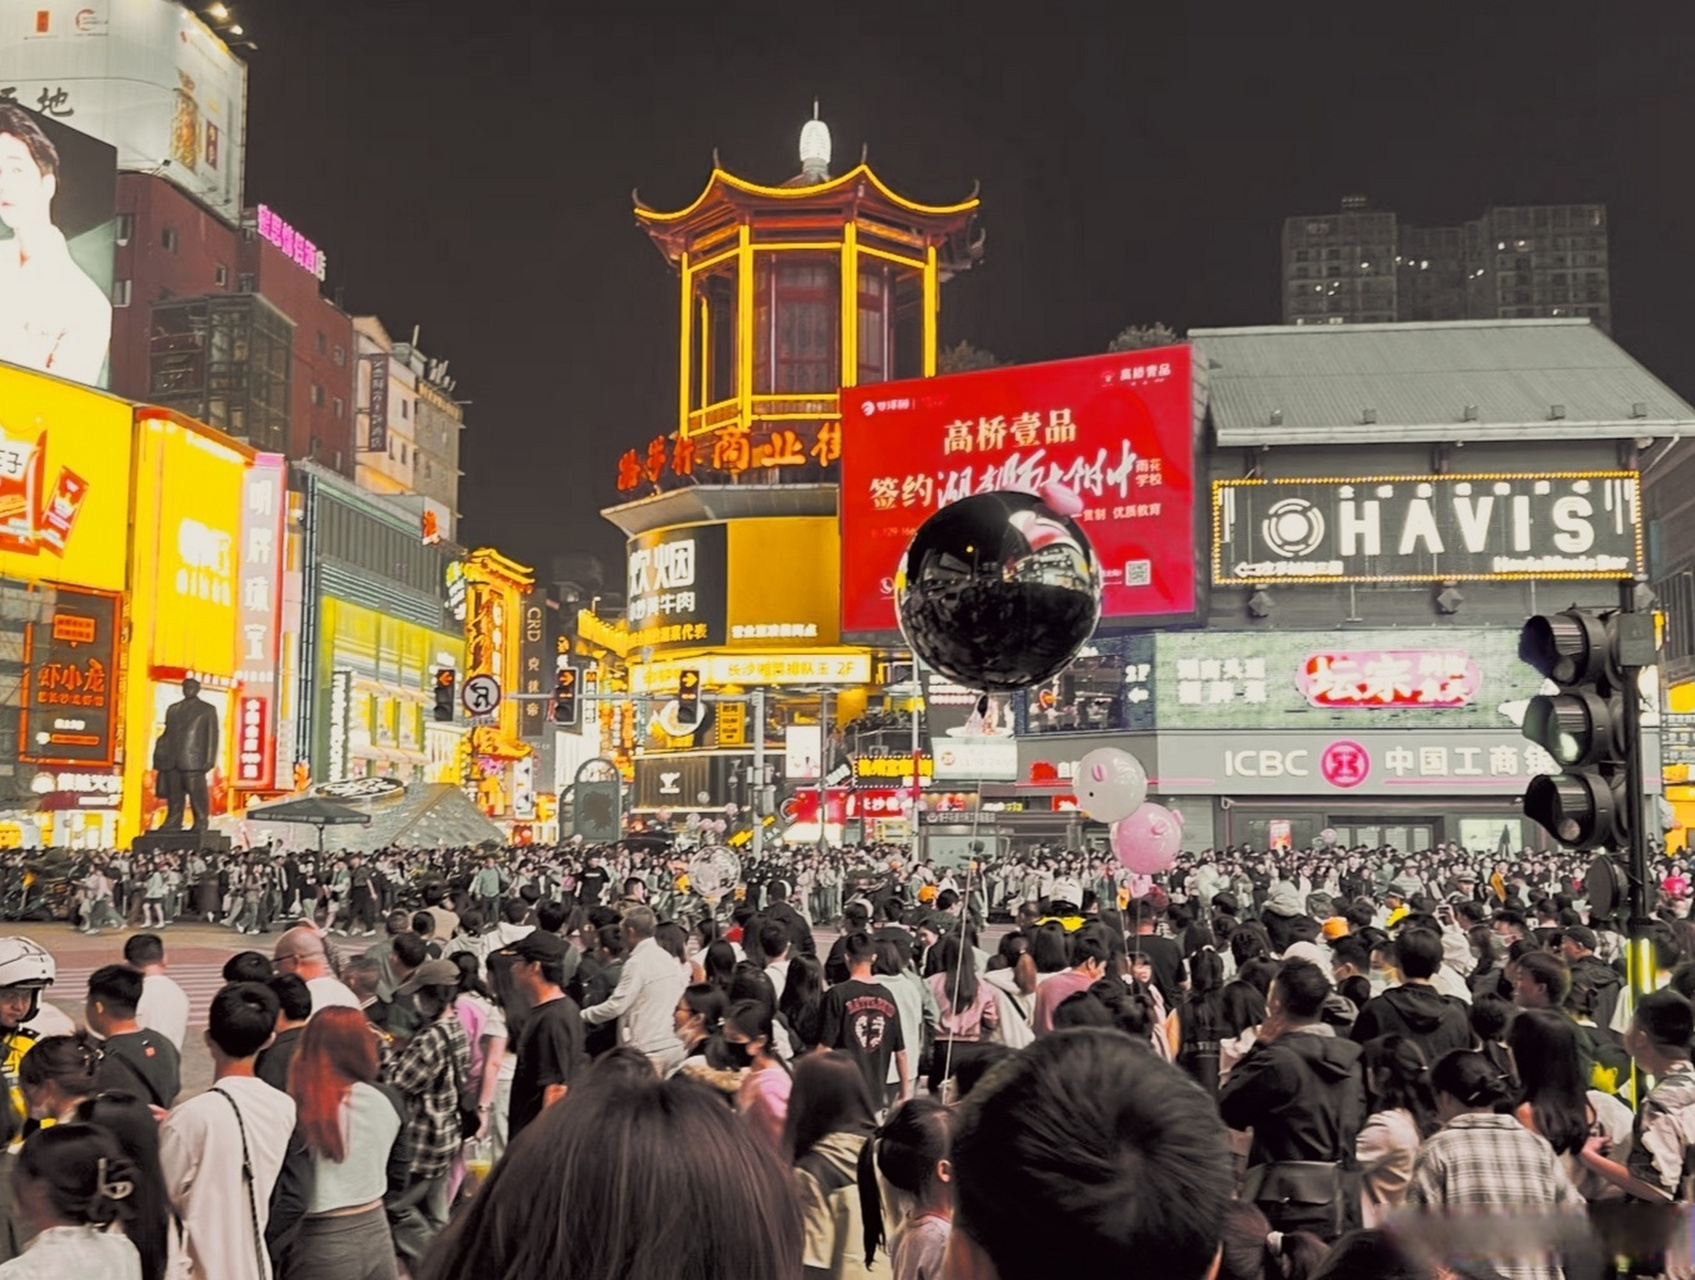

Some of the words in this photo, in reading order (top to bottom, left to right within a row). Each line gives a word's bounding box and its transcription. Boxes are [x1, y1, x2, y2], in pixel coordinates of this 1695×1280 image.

[943, 408, 1077, 456] 高桥壹品
[1136, 458, 1162, 472] 雨花
[1136, 473, 1162, 487] 学校
[868, 473, 934, 511] 签约
[1113, 503, 1161, 519] 优质教育
[1339, 495, 1595, 556] HAVIS
[629, 539, 695, 599] 炊烟
[526, 606, 542, 642] CRD
[37, 658, 105, 692] 虾小龙
[1307, 654, 1413, 702] 坛宗
[1225, 749, 1309, 776] ICBC
